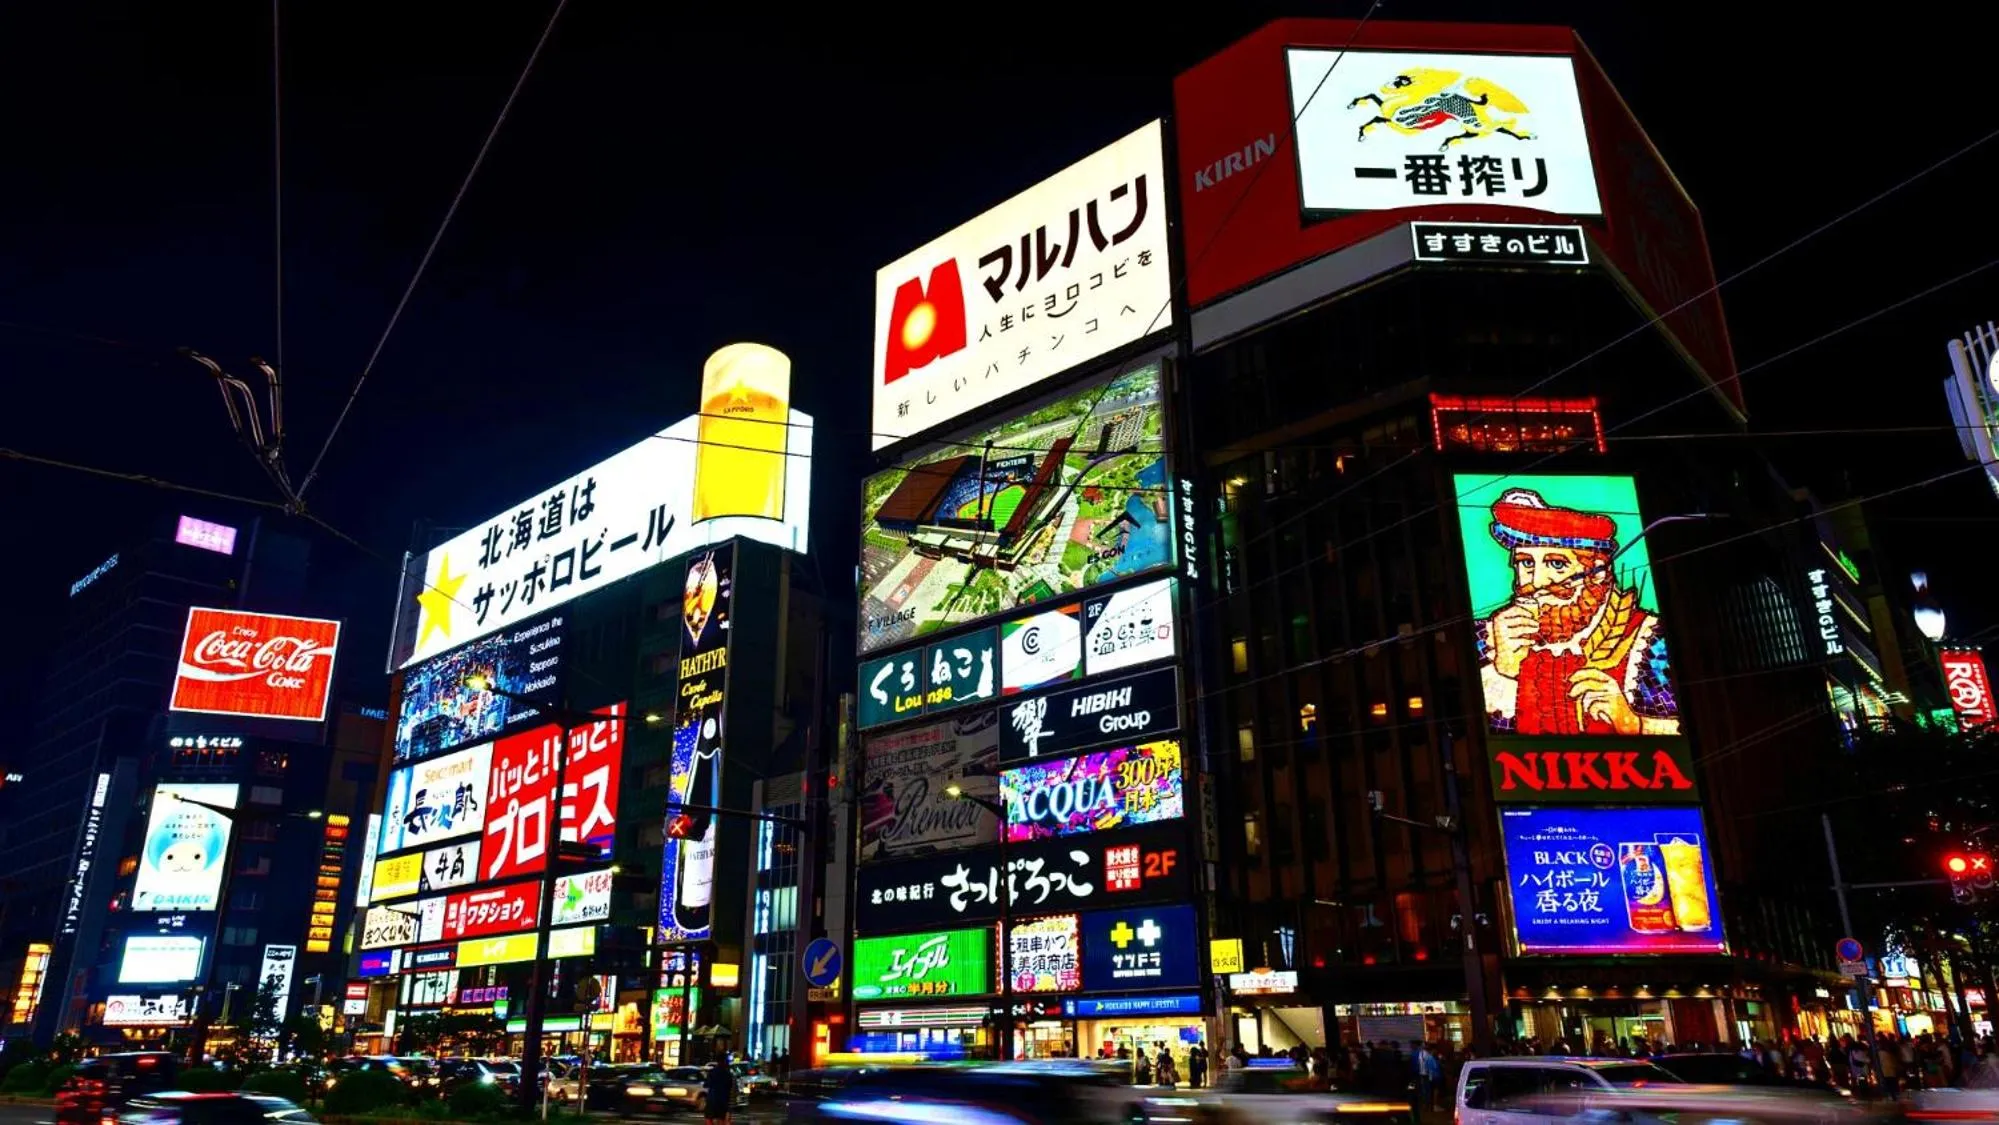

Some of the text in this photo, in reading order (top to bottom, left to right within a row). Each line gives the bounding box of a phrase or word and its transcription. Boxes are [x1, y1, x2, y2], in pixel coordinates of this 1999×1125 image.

[1194, 132, 1276, 193] KIRIN
[1354, 153, 1550, 198] 一番搾り
[977, 173, 1149, 304] マルハン
[1423, 231, 1575, 256] すすきのビル
[978, 249, 1153, 343] 人生にヨロコビを
[478, 476, 597, 569] 北海道は
[472, 502, 676, 626] サッポロビール
[876, 606, 917, 629] VILLAGE
[1088, 603, 1103, 618] 2F
[193, 630, 321, 673] Coca-Cola
[266, 672, 306, 689] Coke
[869, 648, 973, 706] くろねこ
[894, 686, 953, 713] Lounge
[1071, 686, 1133, 718] HIBIKI
[1011, 696, 1056, 757] 響
[1100, 710, 1151, 733] Group
[1495, 750, 1695, 790] NIKKA
[403, 781, 478, 836] 長次郎
[1007, 774, 1117, 825] ACQUA
[1124, 789, 1175, 815] 日本一
[487, 764, 616, 881] プロミス
[434, 846, 465, 880] 牛角
[1144, 850, 1178, 878] 2F
[1534, 850, 1589, 865] BLACK
[871, 882, 935, 905] 北の味紀行
[1519, 869, 1611, 889] ハイボール
[466, 895, 525, 926] ワタショウ
[1535, 888, 1603, 912] 香る夜
[1010, 952, 1075, 972] 美須商店
